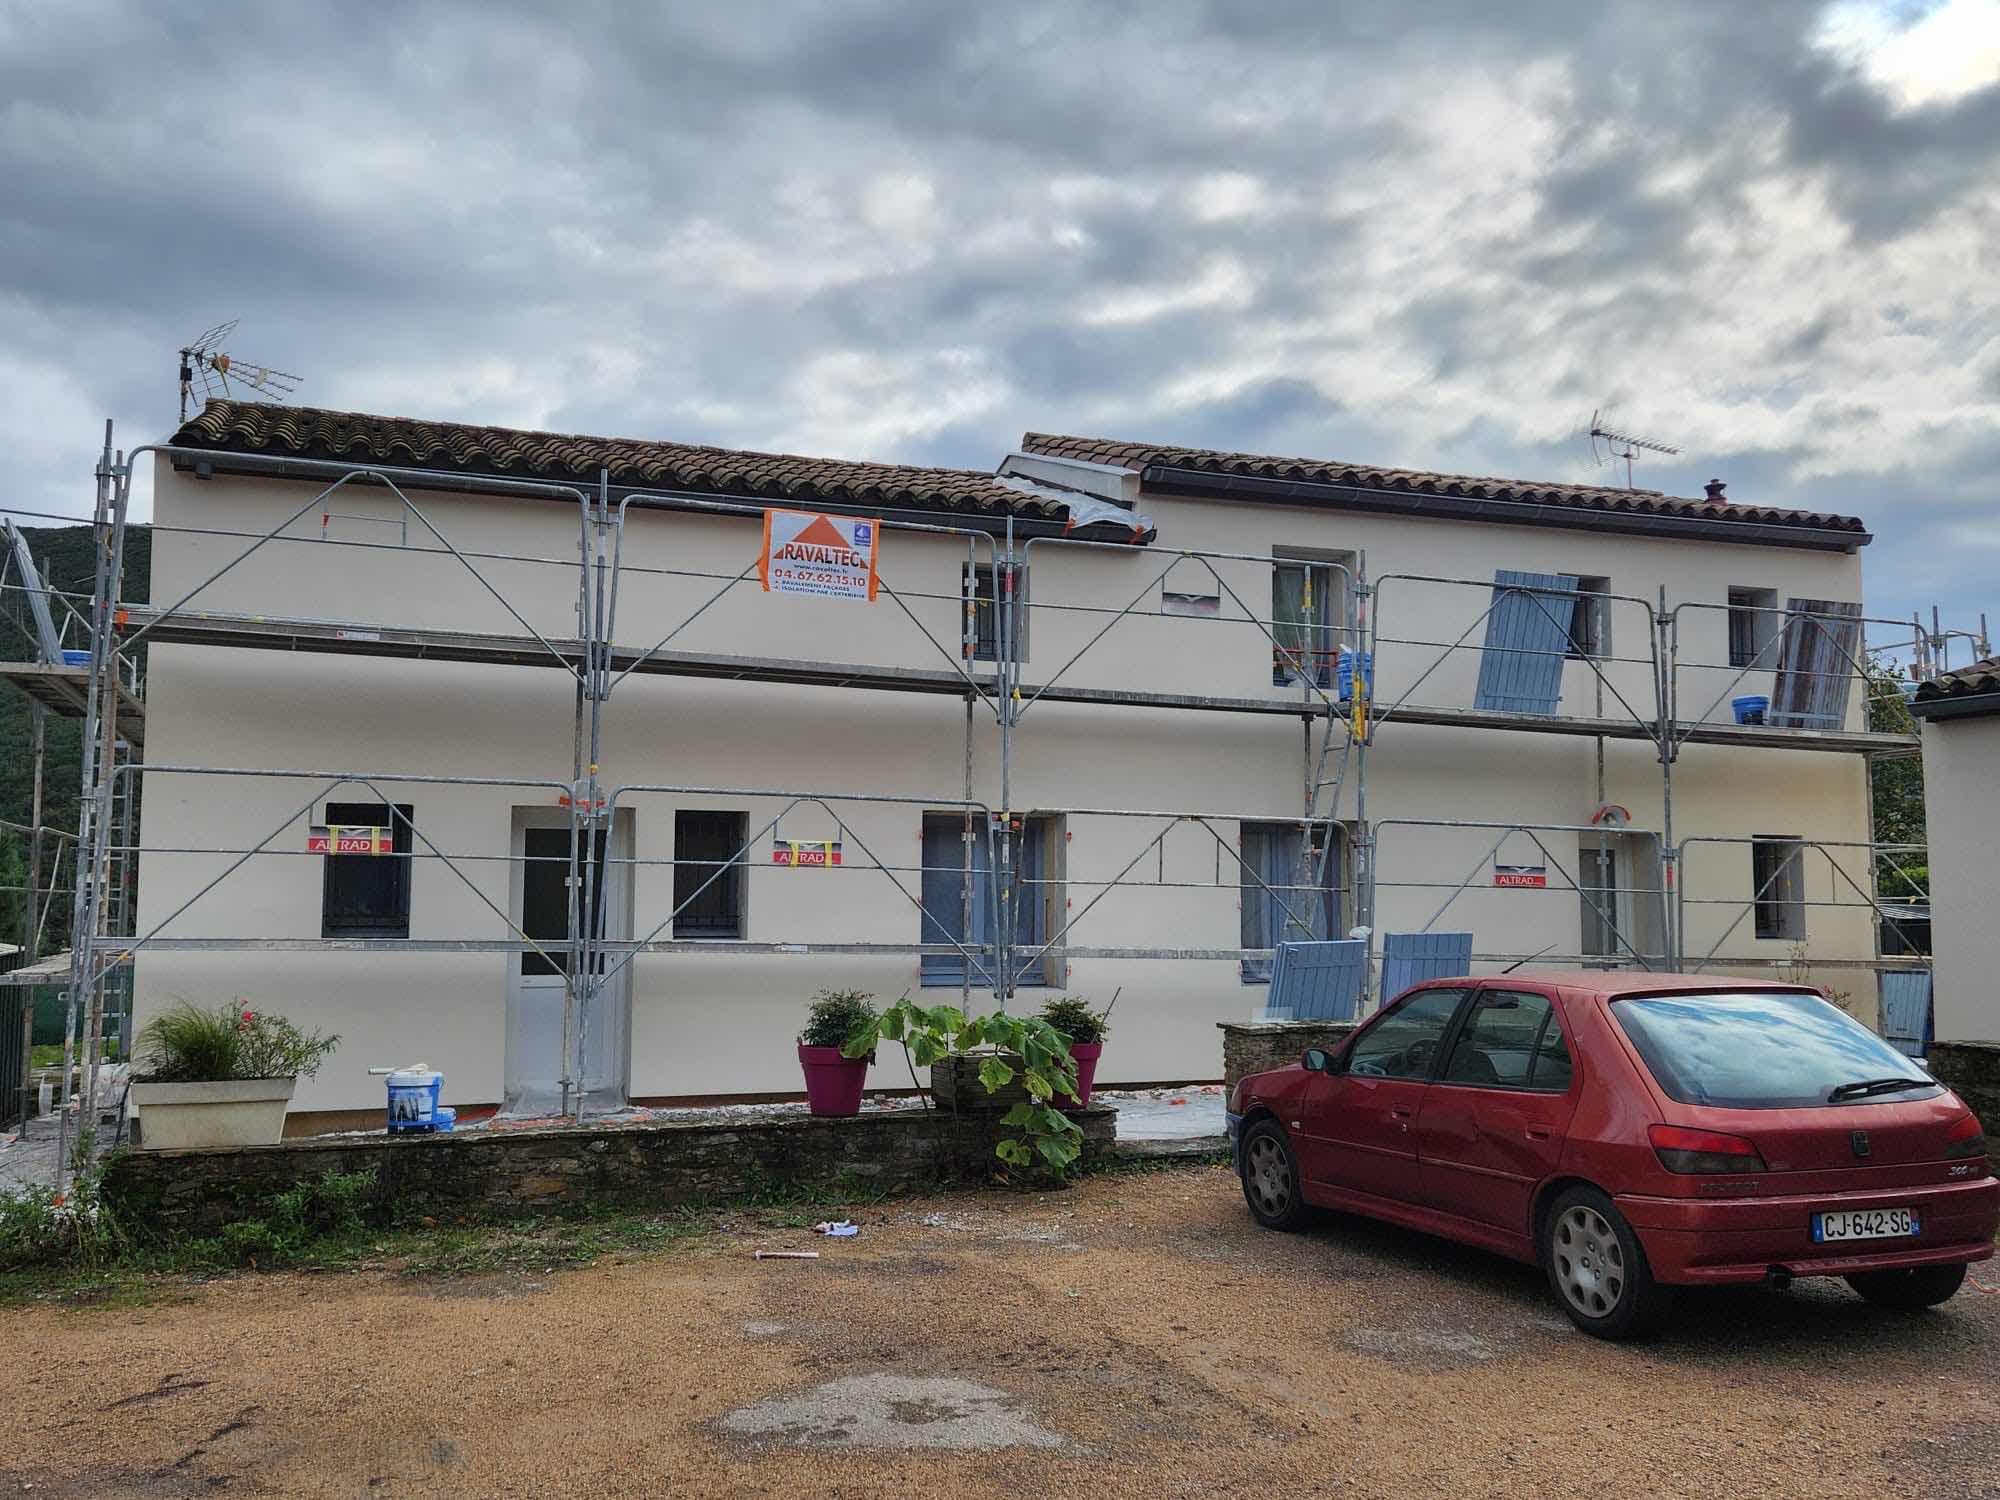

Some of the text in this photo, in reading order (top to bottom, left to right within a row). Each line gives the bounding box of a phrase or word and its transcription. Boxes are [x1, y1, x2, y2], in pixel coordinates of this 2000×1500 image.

[784, 543, 860, 568] RAVALTEC
[774, 568, 866, 587] 04.67.62.15.10
[315, 840, 370, 851] ALRAD
[779, 853, 824, 863] ALRAD
[1500, 876, 1534, 885] ALTRAD
[1825, 1211, 1910, 1237] CJ-642-SG
